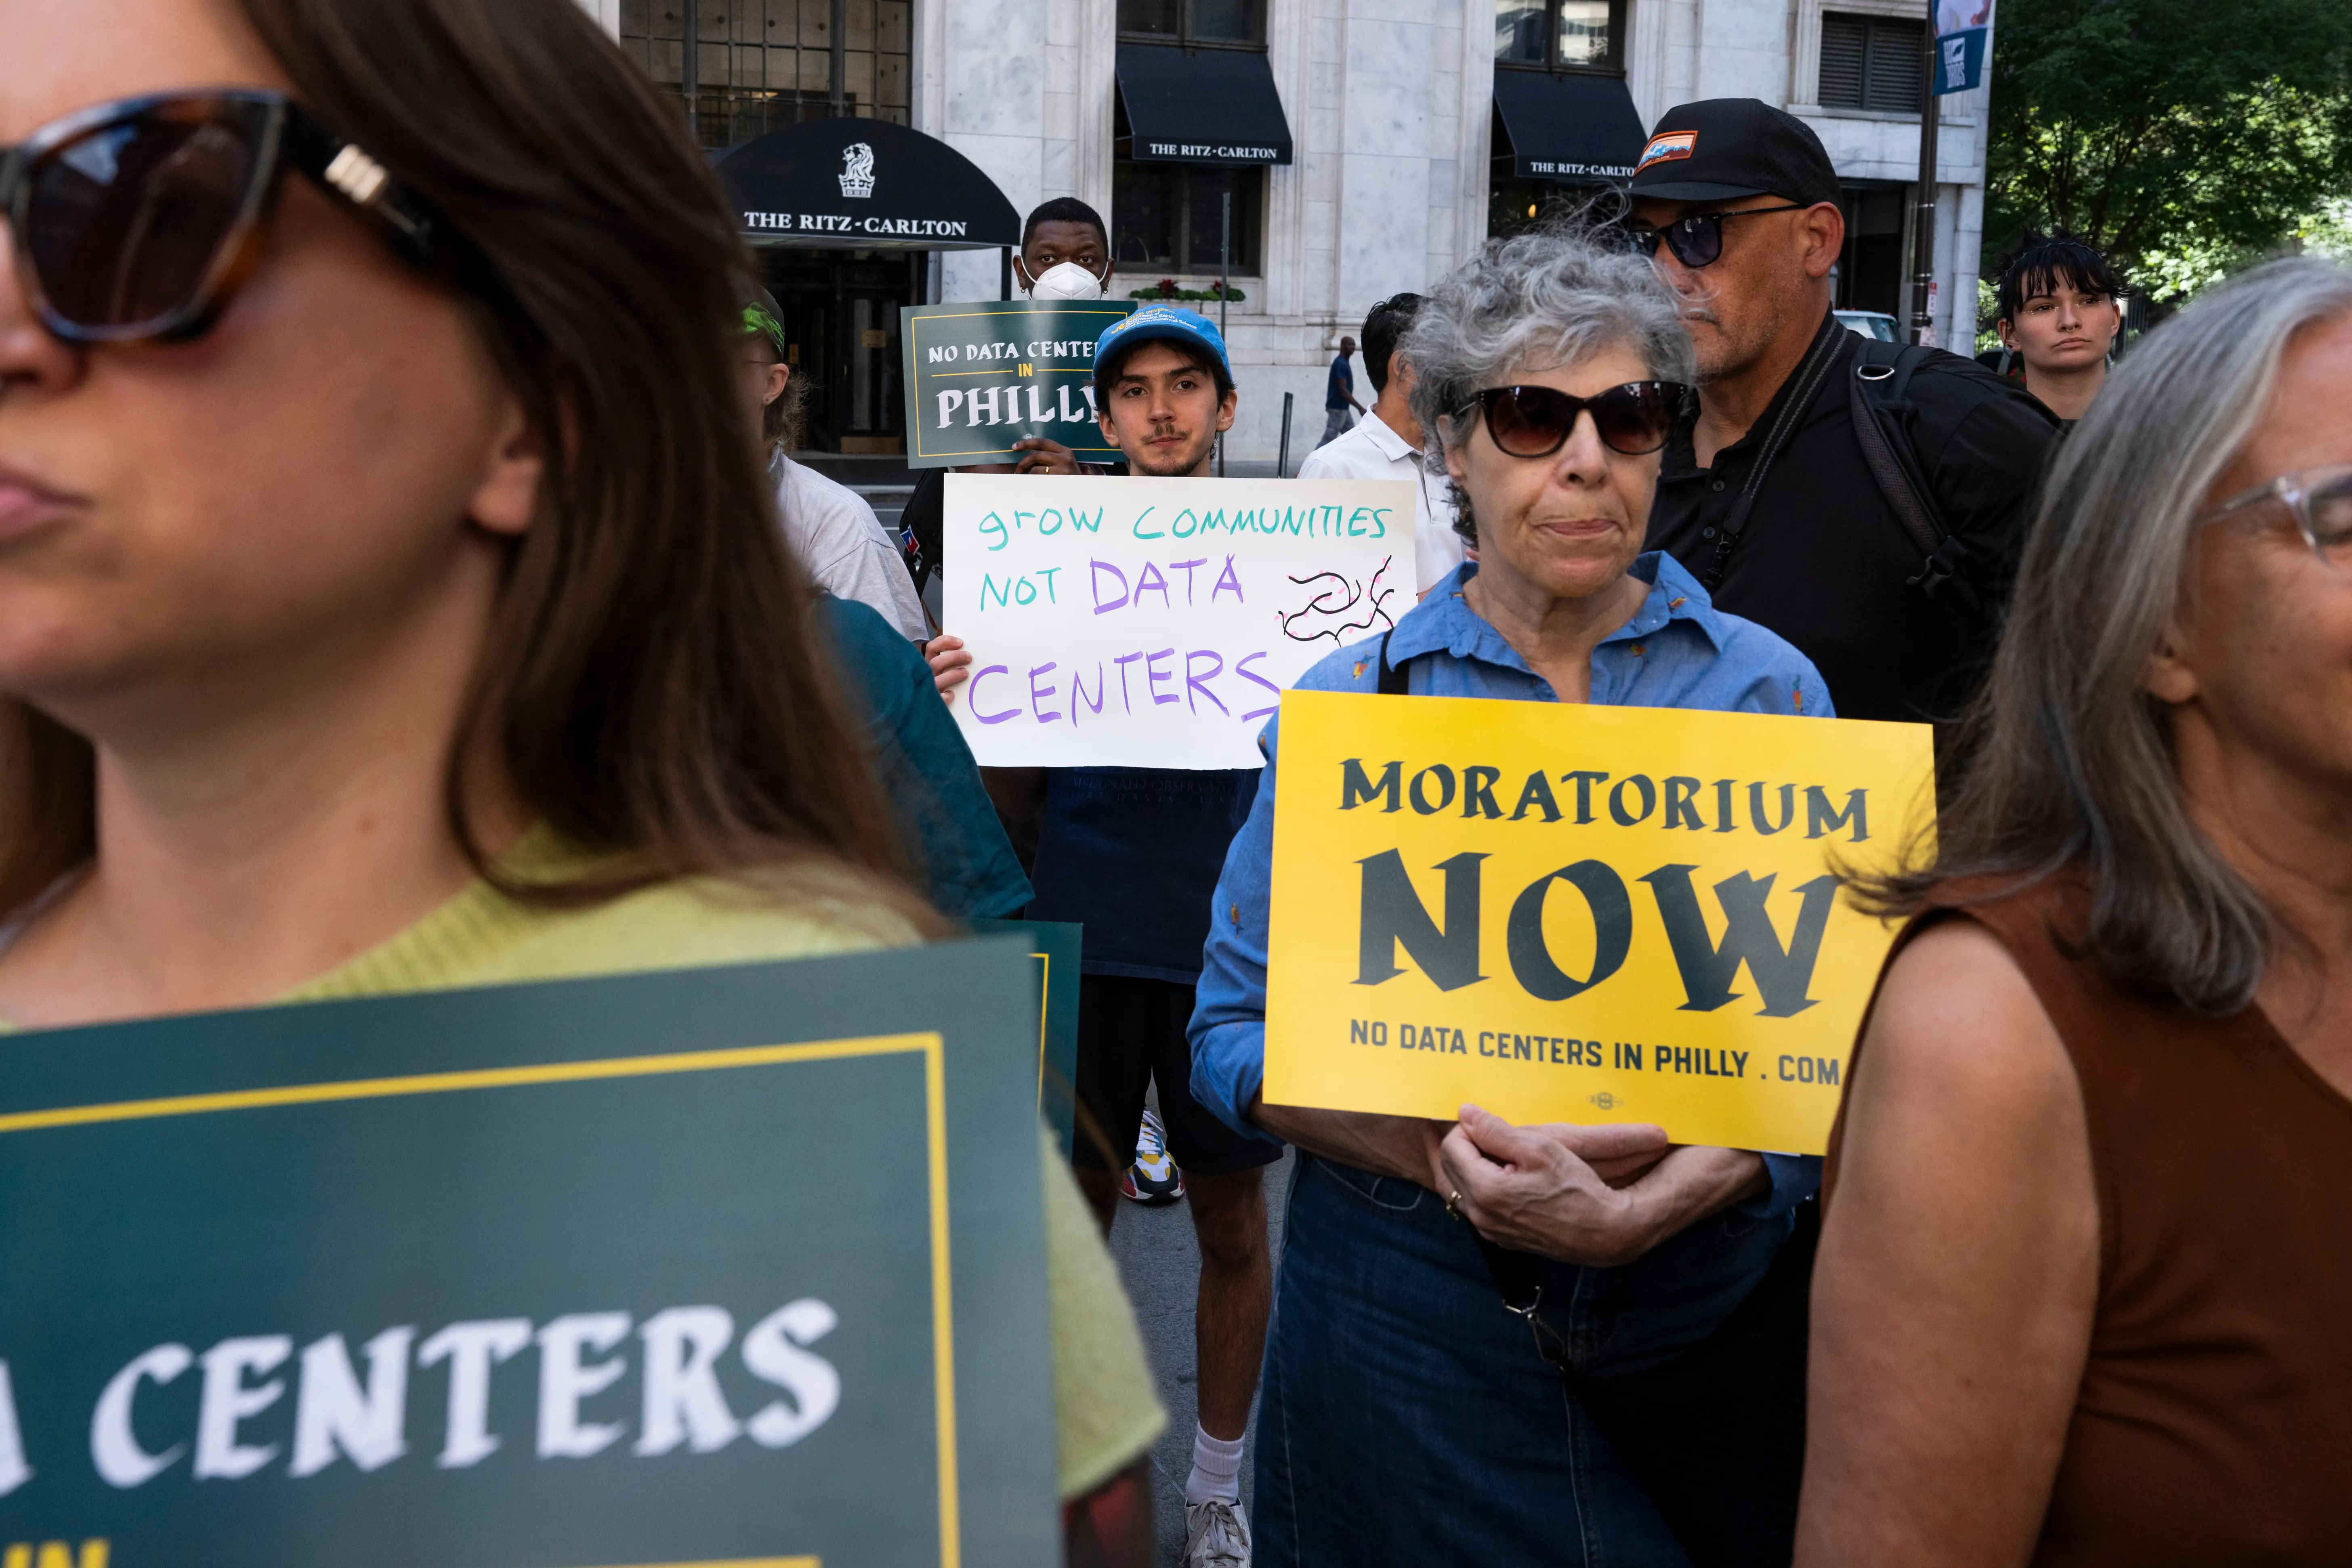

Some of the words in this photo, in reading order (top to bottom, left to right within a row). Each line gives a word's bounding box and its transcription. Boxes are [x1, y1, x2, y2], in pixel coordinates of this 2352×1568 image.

[1150, 144, 1176, 155] THE
[1531, 162, 1554, 172] THE
[744, 212, 791, 228] THE
[799, 215, 966, 236] RITZ-CARLTON
[928, 346, 958, 363] NO
[965, 342, 1020, 361] DATA
[1027, 341, 1097, 358] CENTE
[1019, 363, 1032, 377] IN
[981, 567, 1061, 611] NOT
[1090, 554, 1243, 615] DATA
[969, 648, 1280, 727] CENTERS
[1339, 759, 1867, 842] MORATORIUM
[1350, 848, 1840, 1018] NOW
[1352, 1020, 1386, 1045] NO
[1401, 1025, 1466, 1054] DATA
[1480, 1032, 1602, 1067] CENTERS
[1615, 1043, 1642, 1070] IN
[1655, 1045, 1748, 1078] PHILLY
[1779, 1055, 1839, 1085] COM
[91, 1297, 841, 1488] CENTERS
